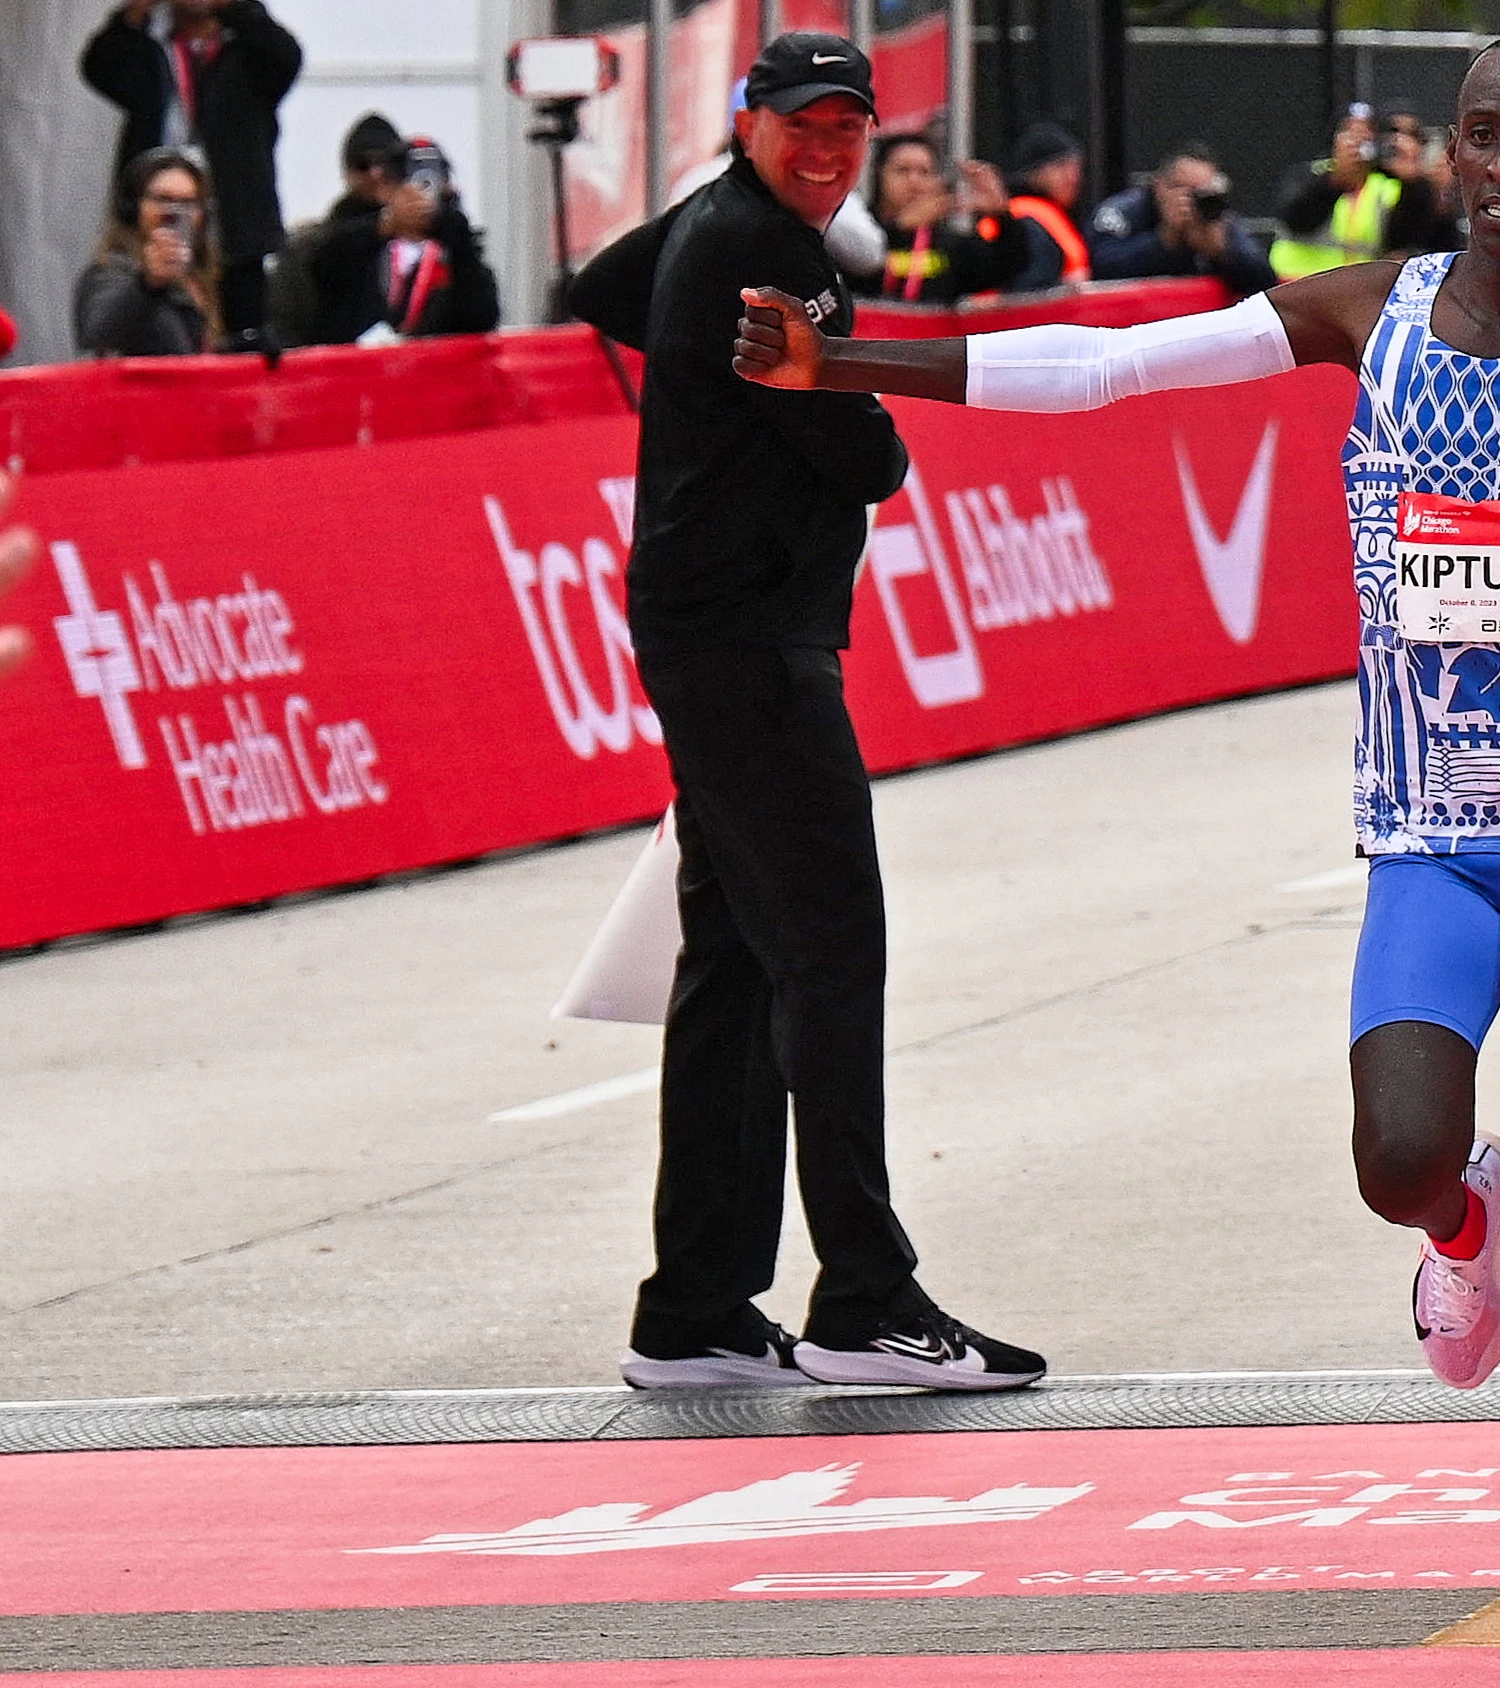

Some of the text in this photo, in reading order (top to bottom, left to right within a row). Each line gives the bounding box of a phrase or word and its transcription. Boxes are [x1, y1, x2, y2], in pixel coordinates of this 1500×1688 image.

[946, 477, 1113, 630] Abbott
[123, 559, 302, 691] Advocate
[158, 692, 389, 836] Health Care
[1016, 1571, 1303, 1585] WORLD
